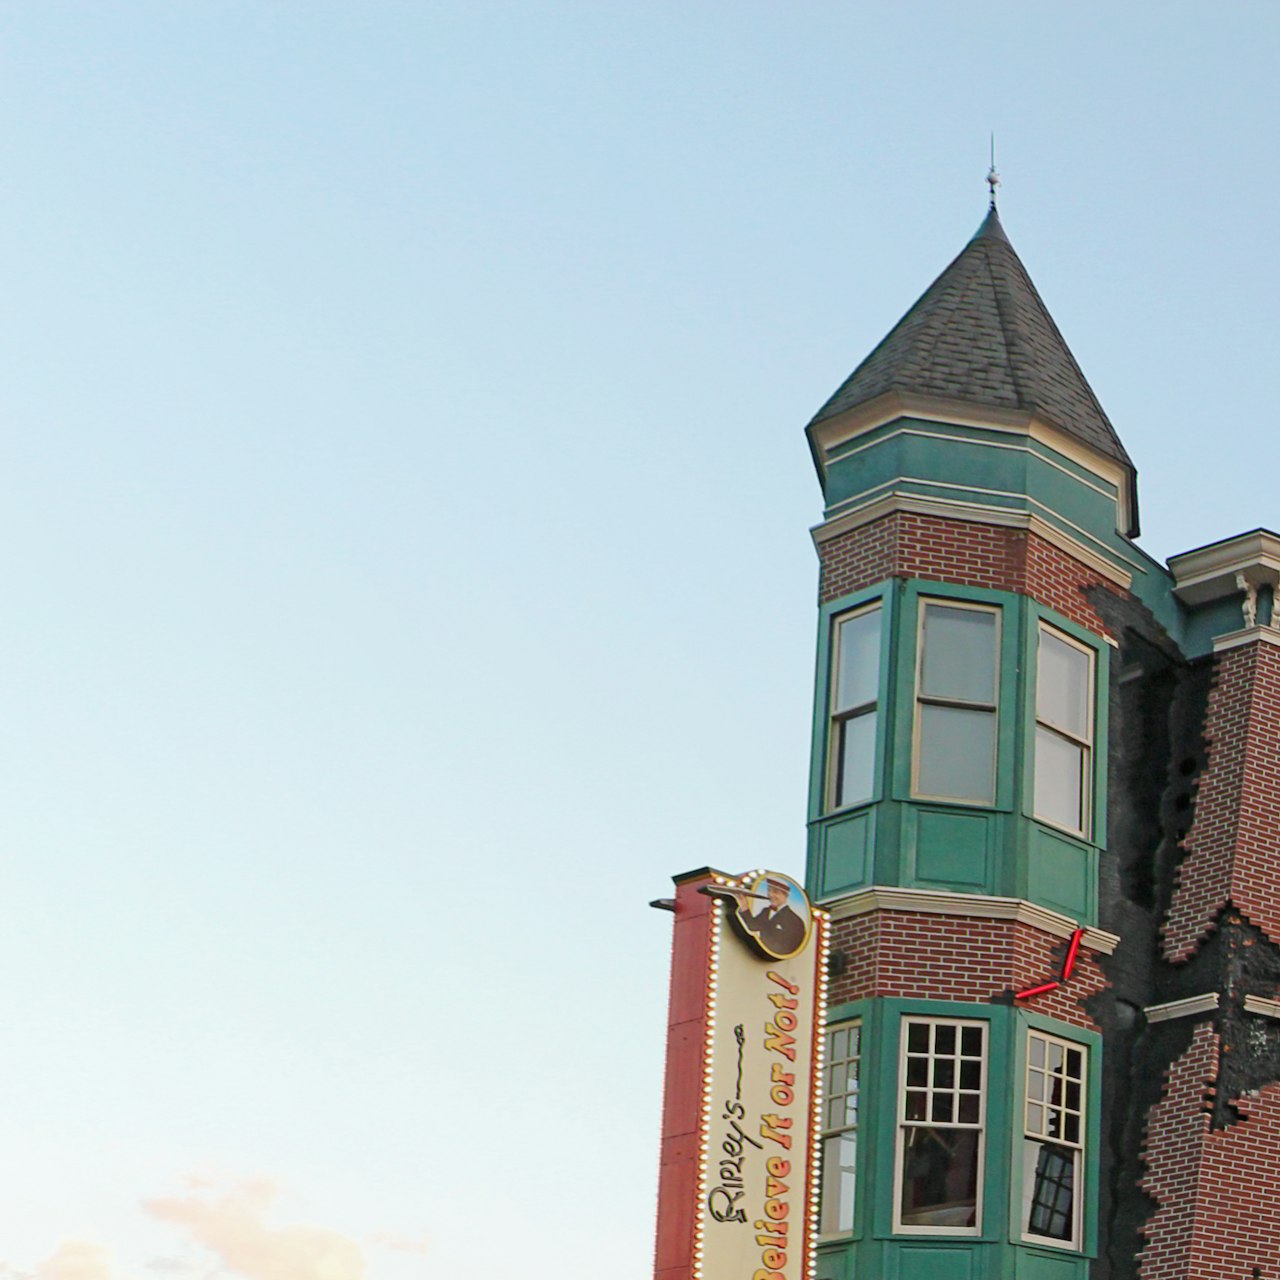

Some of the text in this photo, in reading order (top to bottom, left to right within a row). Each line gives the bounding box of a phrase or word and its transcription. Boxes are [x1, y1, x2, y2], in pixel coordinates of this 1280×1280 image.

[764, 971, 801, 1062] Not!
[770, 1062, 796, 1106] or
[759, 1109, 794, 1150] It
